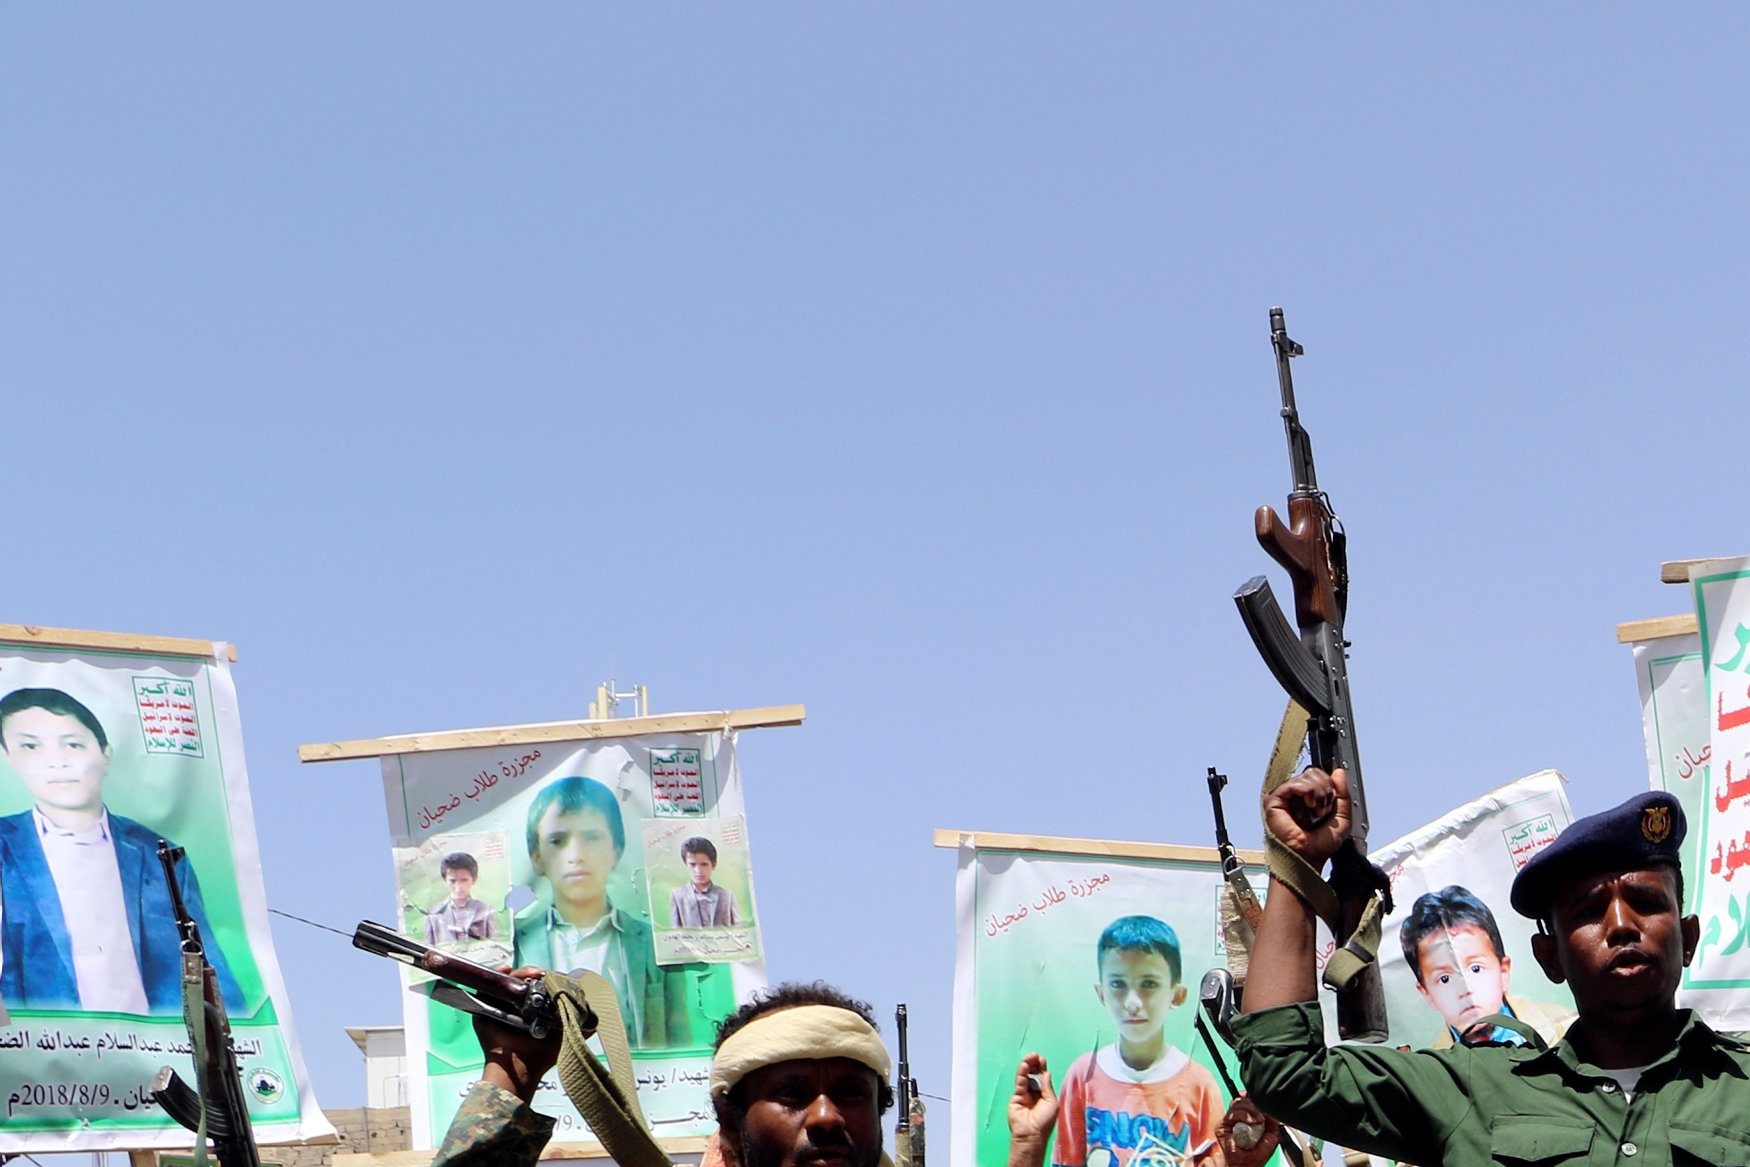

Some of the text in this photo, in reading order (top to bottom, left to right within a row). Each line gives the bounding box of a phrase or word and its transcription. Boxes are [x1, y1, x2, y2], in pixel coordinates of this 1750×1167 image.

[417, 750, 541, 829] مجزرة طلاب ضحيان
[985, 873, 1111, 937] مجزرة طلاب ضحيان
[1085, 1106, 1191, 1153] SNOW
